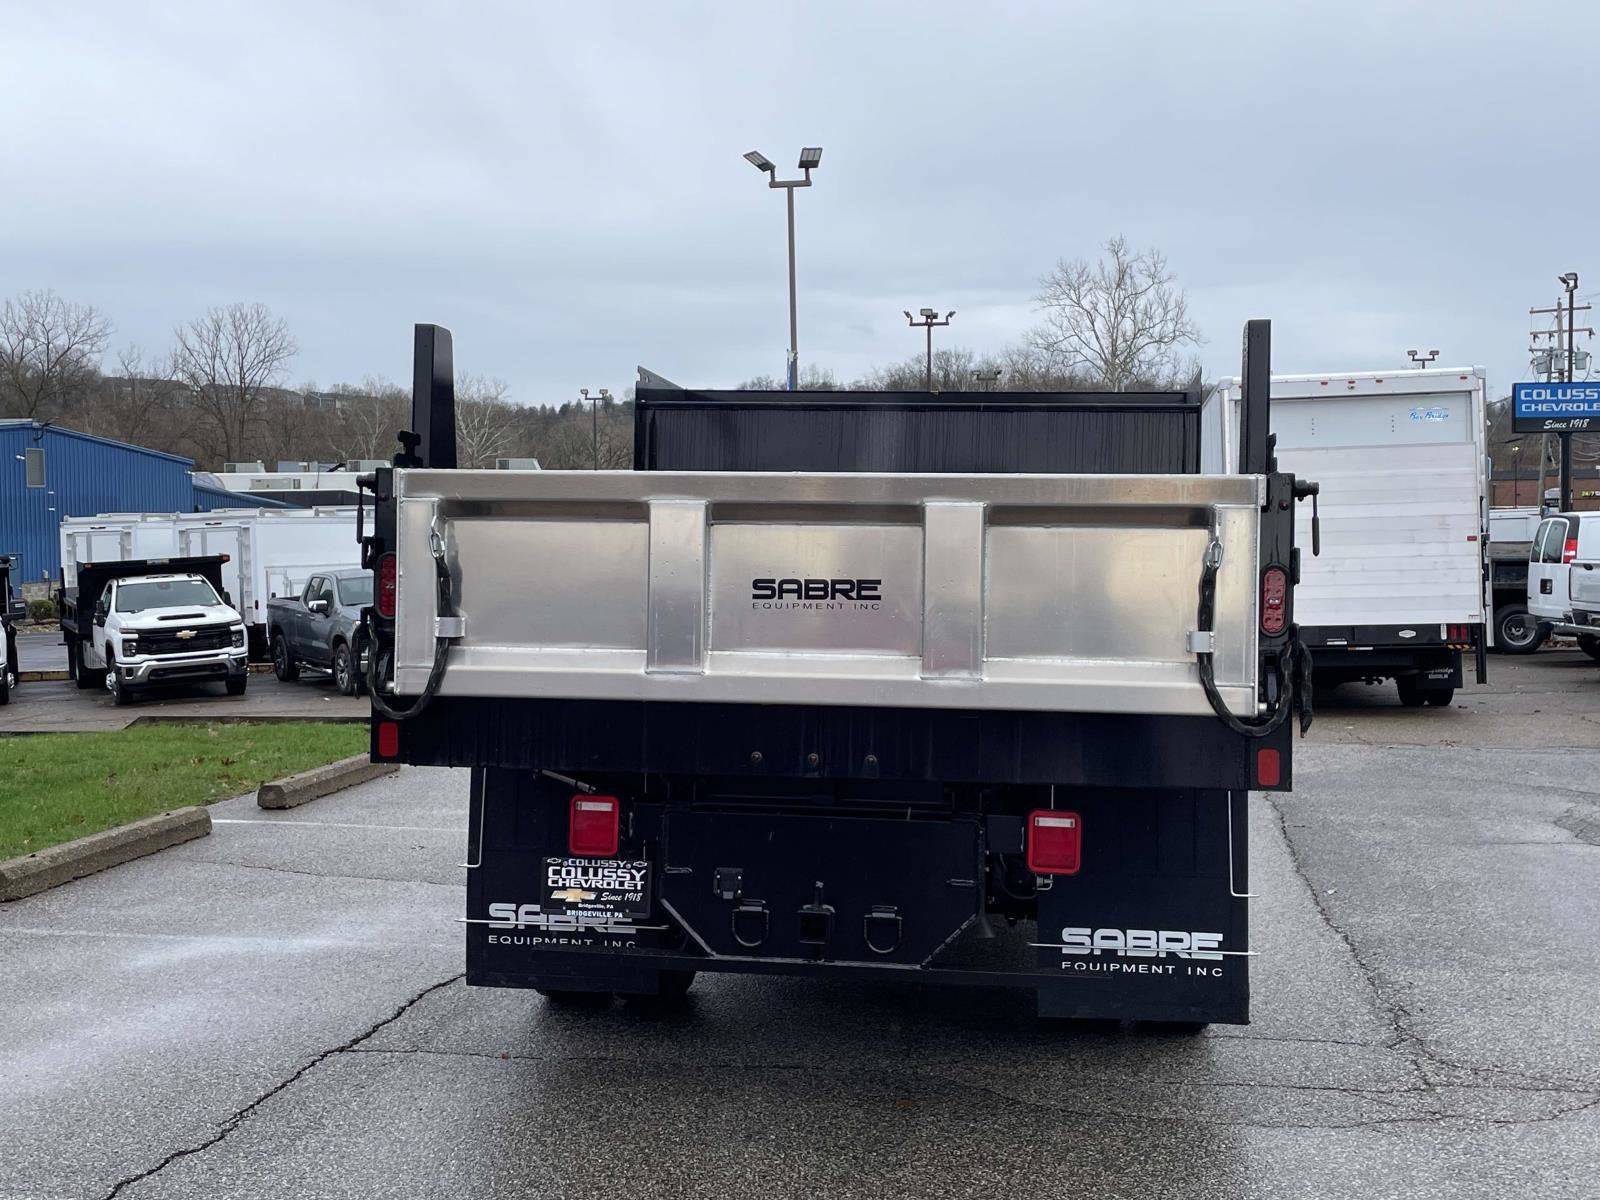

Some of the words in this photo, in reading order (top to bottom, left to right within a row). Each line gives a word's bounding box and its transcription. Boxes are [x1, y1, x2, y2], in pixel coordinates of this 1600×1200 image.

[1520, 389, 1600, 400] COLUSS
[1544, 420, 1567, 429] Since
[1569, 419, 1590, 428] 1918
[752, 579, 882, 601] SABRE
[752, 602, 844, 610] EQUIPMENT
[854, 603, 880, 611] INC
[568, 858, 627, 868] COLUSSY
[547, 866, 647, 881] COLUSSY
[547, 878, 645, 890] CHEVROLET
[600, 892, 622, 901] Since
[624, 892, 643, 902] 1918
[1062, 927, 1223, 960] SABRE
[1187, 966, 1223, 977] INC
